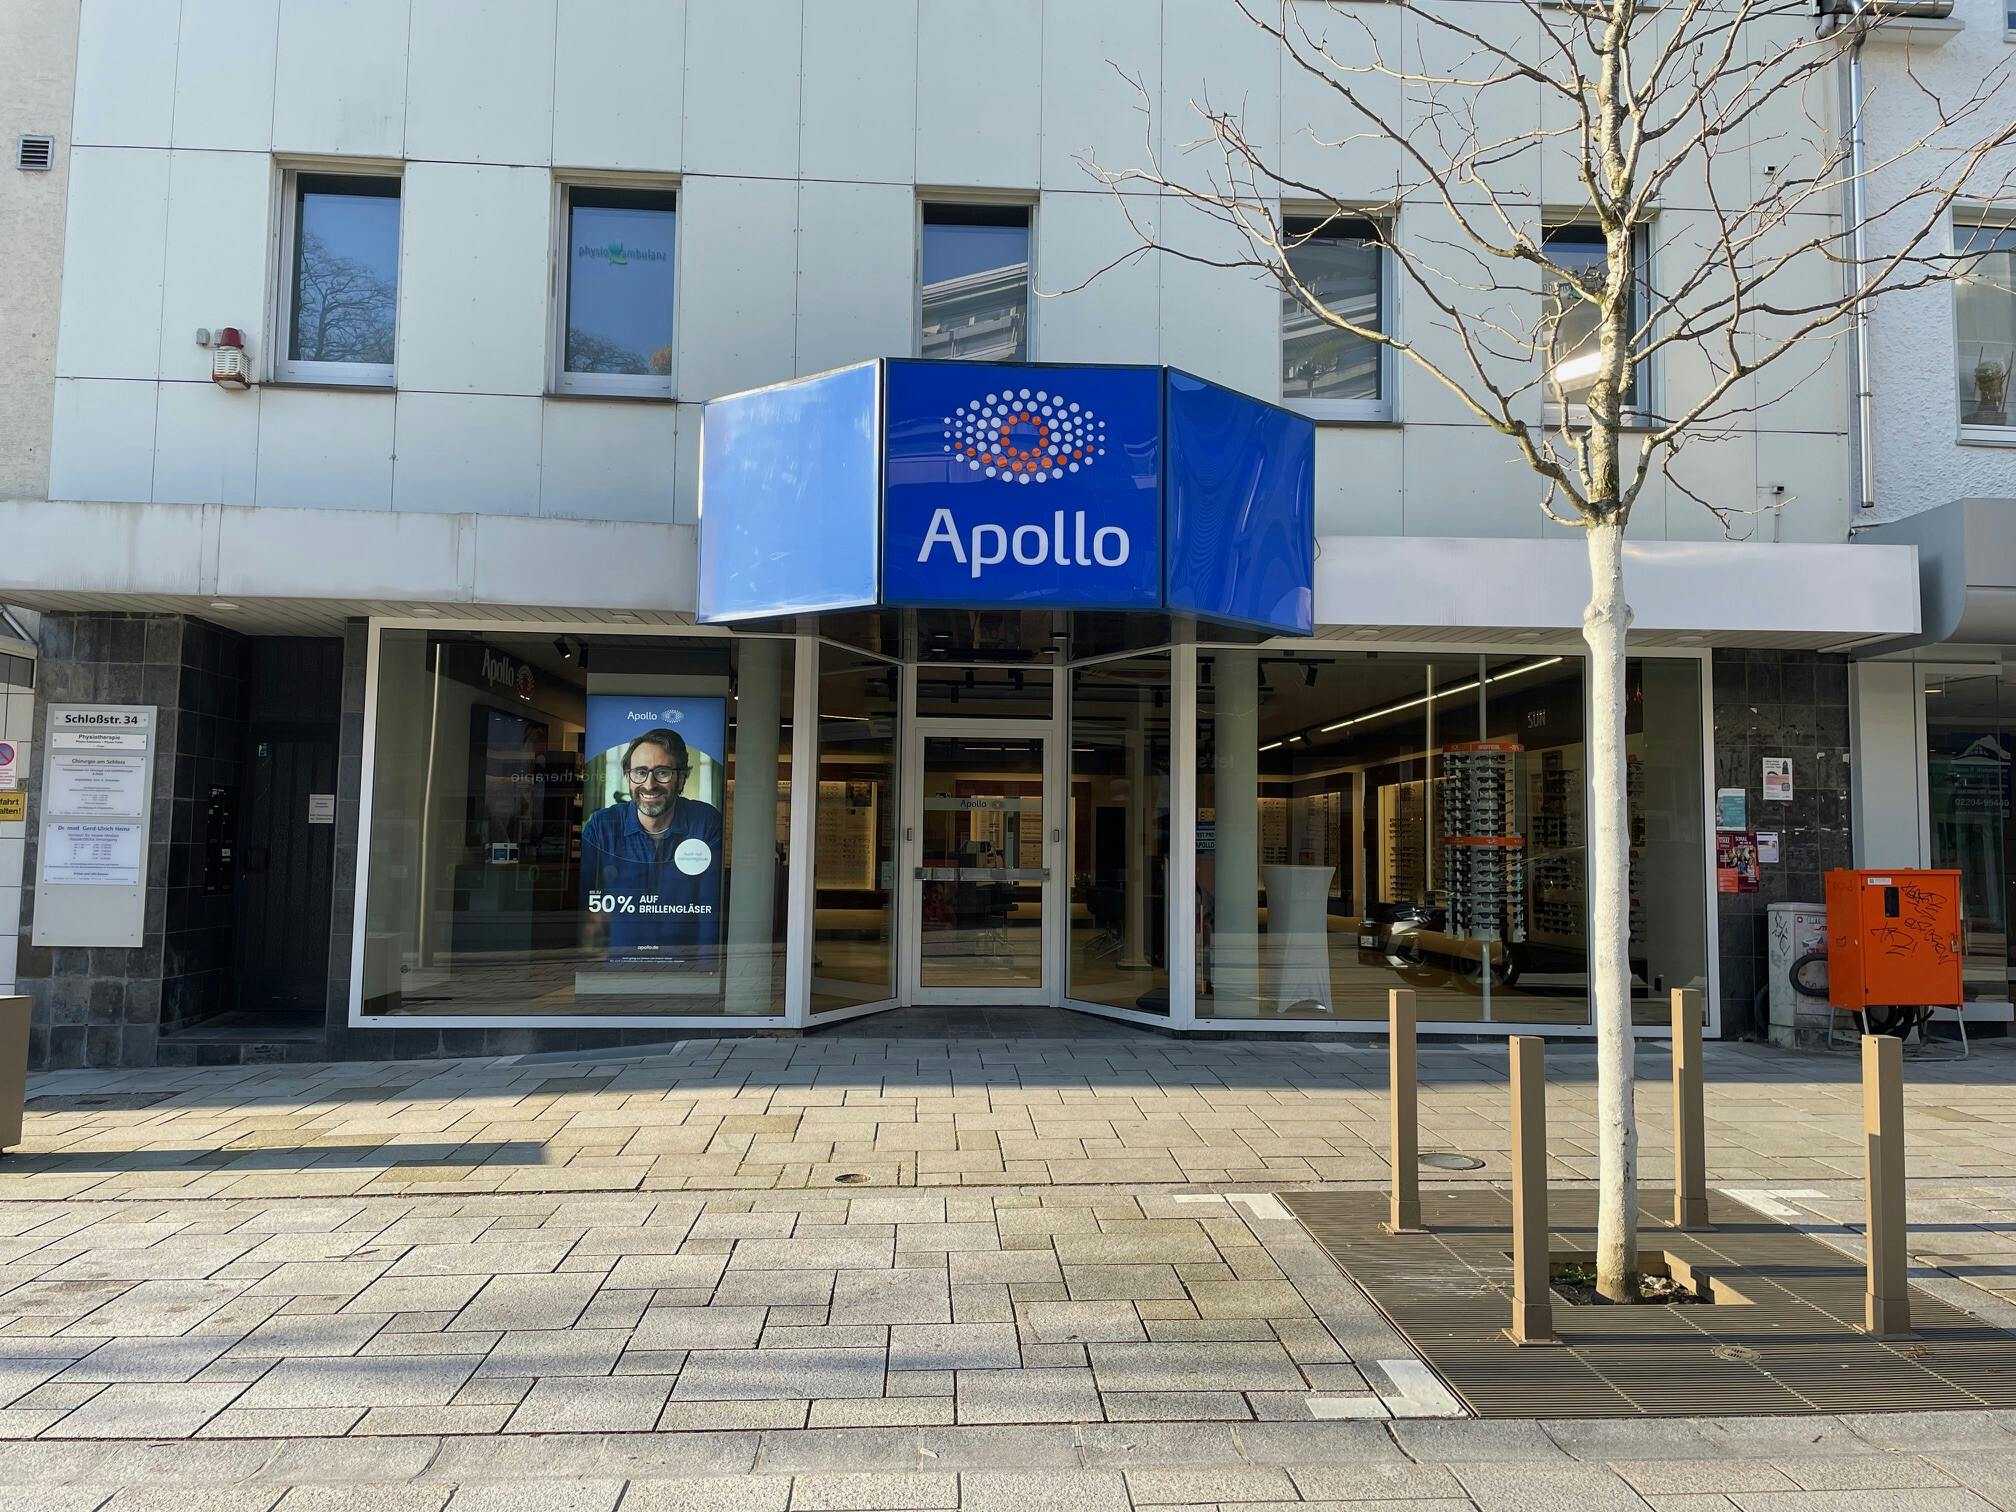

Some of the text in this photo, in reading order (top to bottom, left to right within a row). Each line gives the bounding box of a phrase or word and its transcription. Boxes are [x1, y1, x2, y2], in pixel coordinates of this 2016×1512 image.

[578, 245, 609, 258] physio
[917, 508, 1130, 579] Apollo
[481, 648, 515, 688] Apollo
[65, 714, 138, 725] Schloßstr. 34
[627, 711, 658, 722] Apollo
[1527, 708, 1546, 729] SUN
[960, 799, 987, 809] Apollo
[588, 894, 636, 914] 50%
[639, 895, 659, 904] AUF
[639, 903, 712, 914] BRILLENGLÄSER
